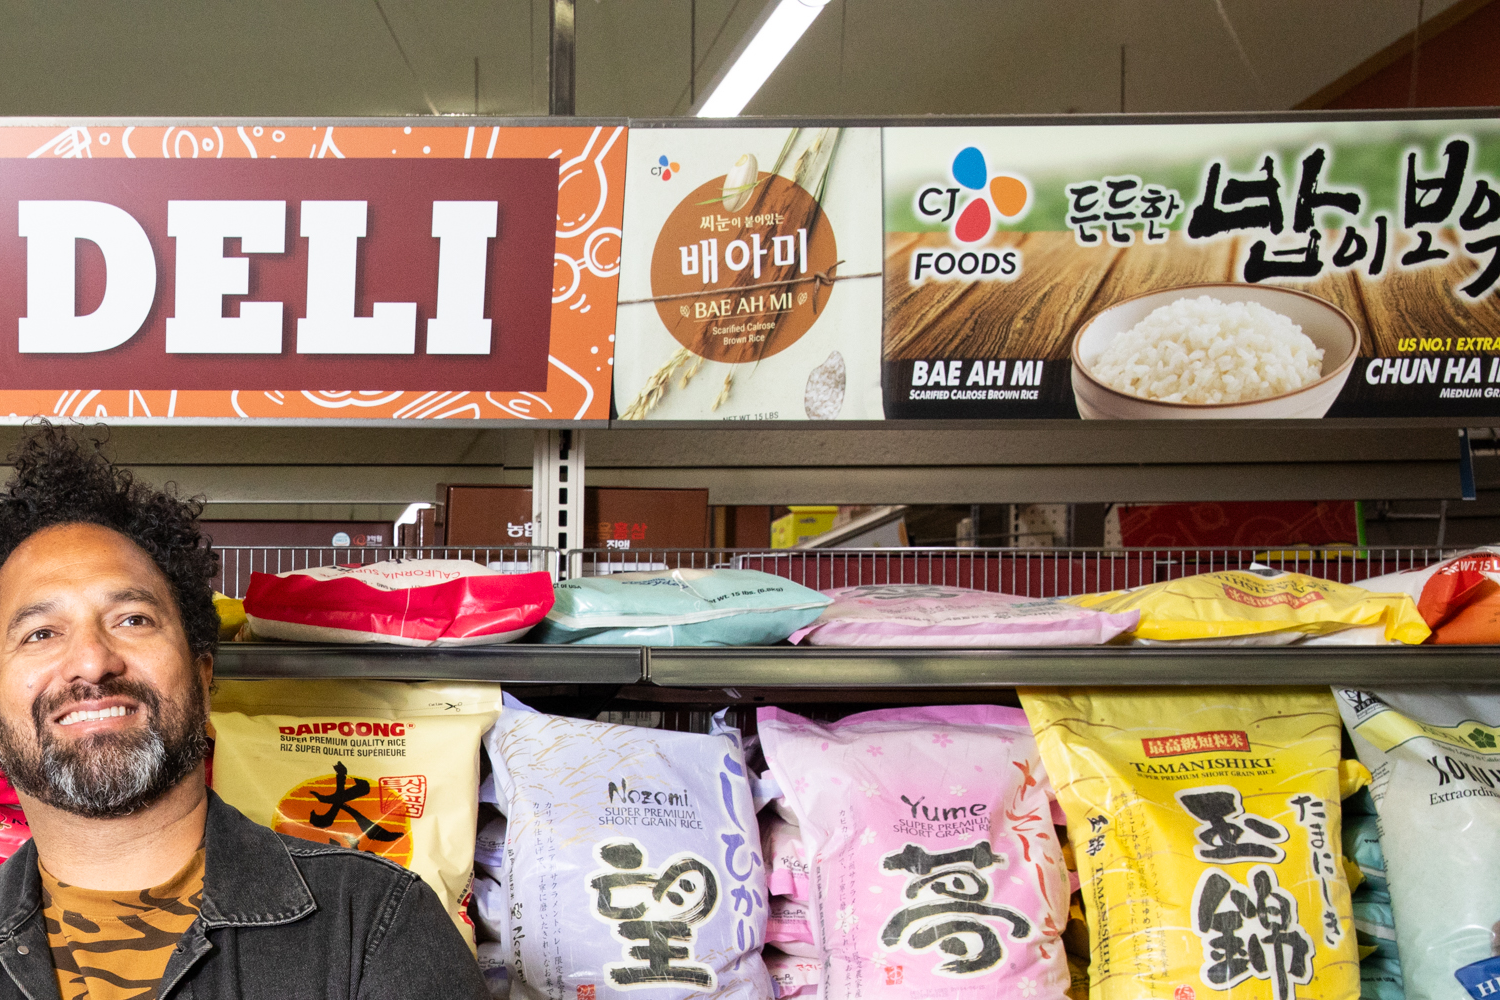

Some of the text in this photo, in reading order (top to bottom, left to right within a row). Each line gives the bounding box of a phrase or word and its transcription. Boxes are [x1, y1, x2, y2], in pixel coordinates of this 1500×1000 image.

[1069, 179, 1179, 243] 든든한
[679, 228, 808, 284] 배아미
[914, 251, 1017, 280] FOODS
[18, 200, 497, 356] DELI
[695, 292, 793, 318] BAE AH MI
[713, 320, 775, 335] Scarified Calrose
[723, 333, 765, 345] Brown Rice
[1398, 338, 1416, 351] US
[911, 360, 1042, 388] BAE AH MI
[1365, 357, 1481, 385] CHUN HA
[988, 389, 1019, 400] BROWN
[1020, 389, 1038, 400] RICE
[1440, 388, 1500, 398] MEDIUM GR
[1130, 757, 1276, 775] TAMANISHIKI
[605, 807, 697, 820] SUPER PREMIUM
[901, 794, 988, 822] Yume
[598, 815, 703, 830] SHORT GRAIN RICE
